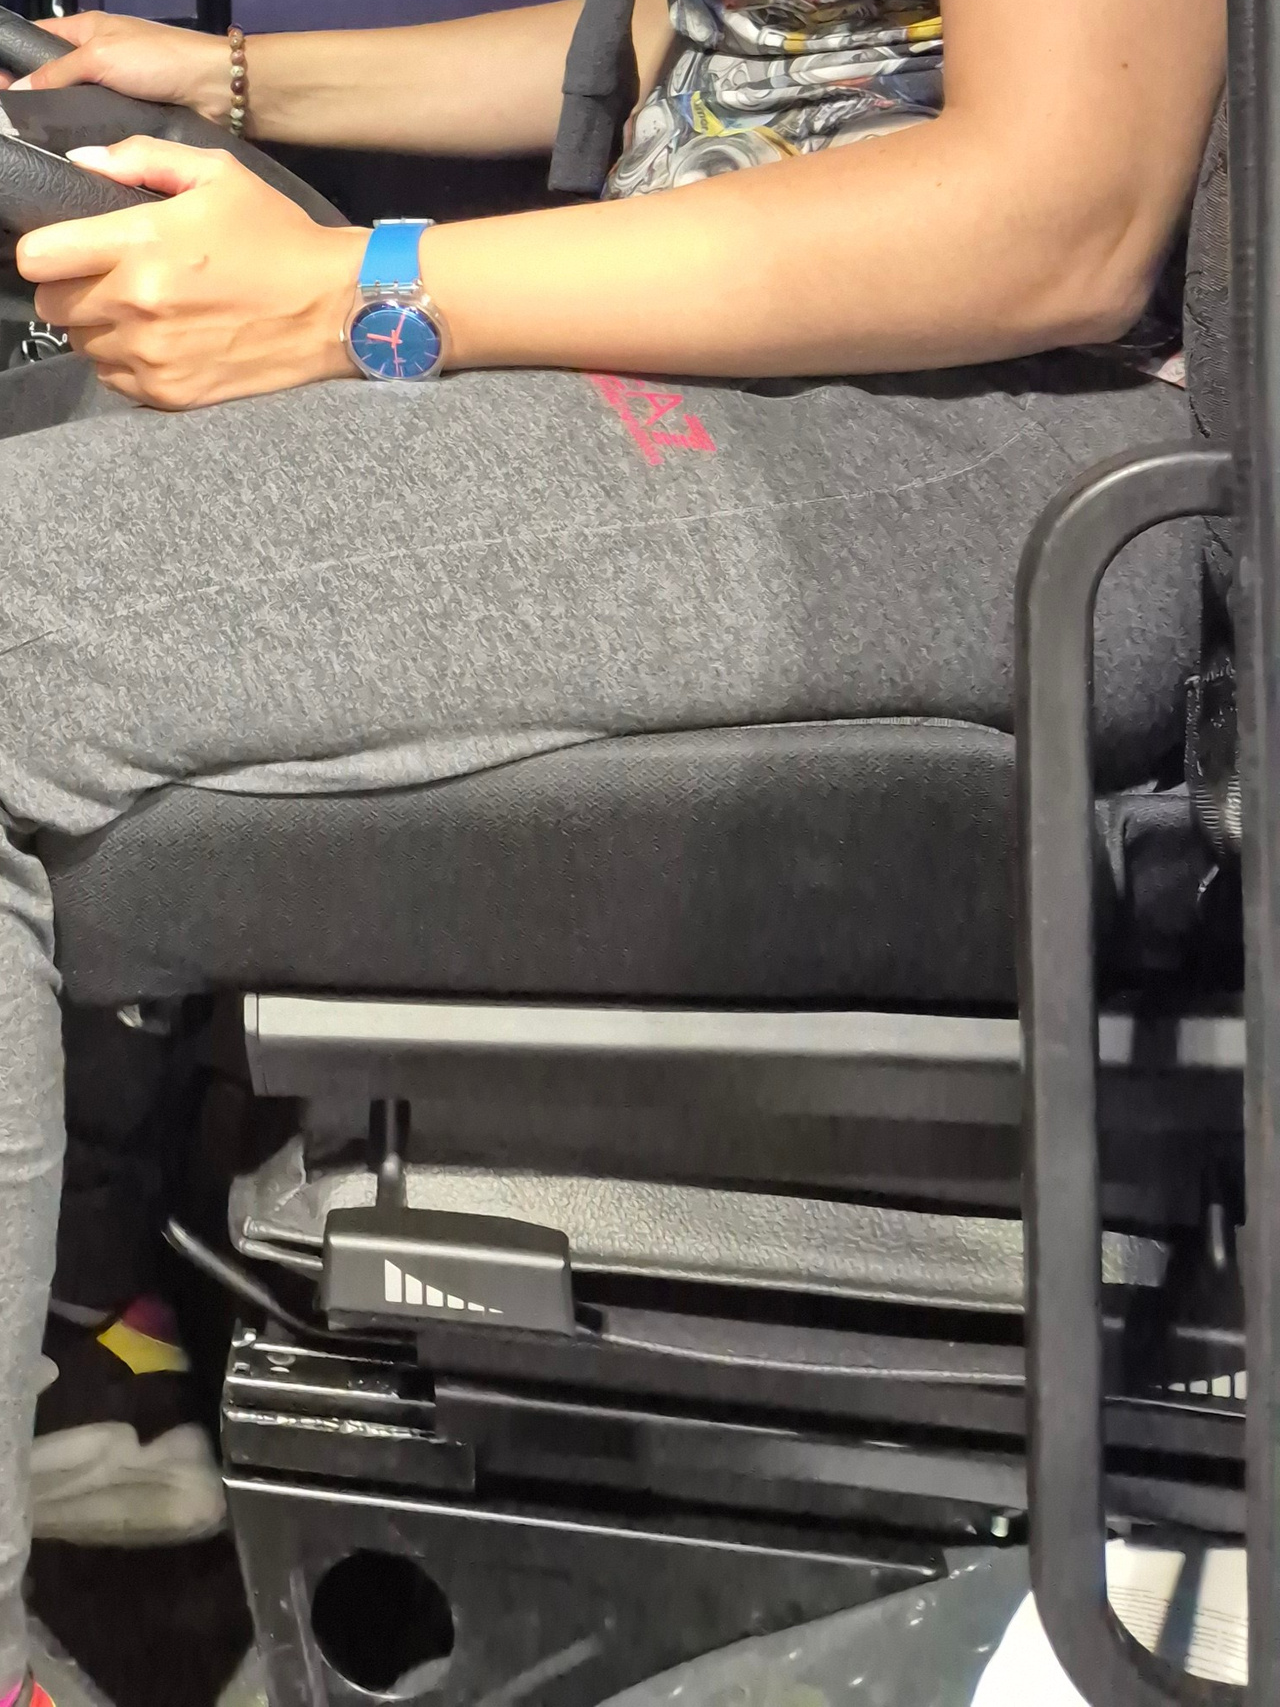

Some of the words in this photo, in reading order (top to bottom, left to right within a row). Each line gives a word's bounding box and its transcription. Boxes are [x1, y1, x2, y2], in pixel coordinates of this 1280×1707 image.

[29, 321, 35, 331] 2
[46, 323, 51, 331] 1
[62, 333, 68, 343] 0
